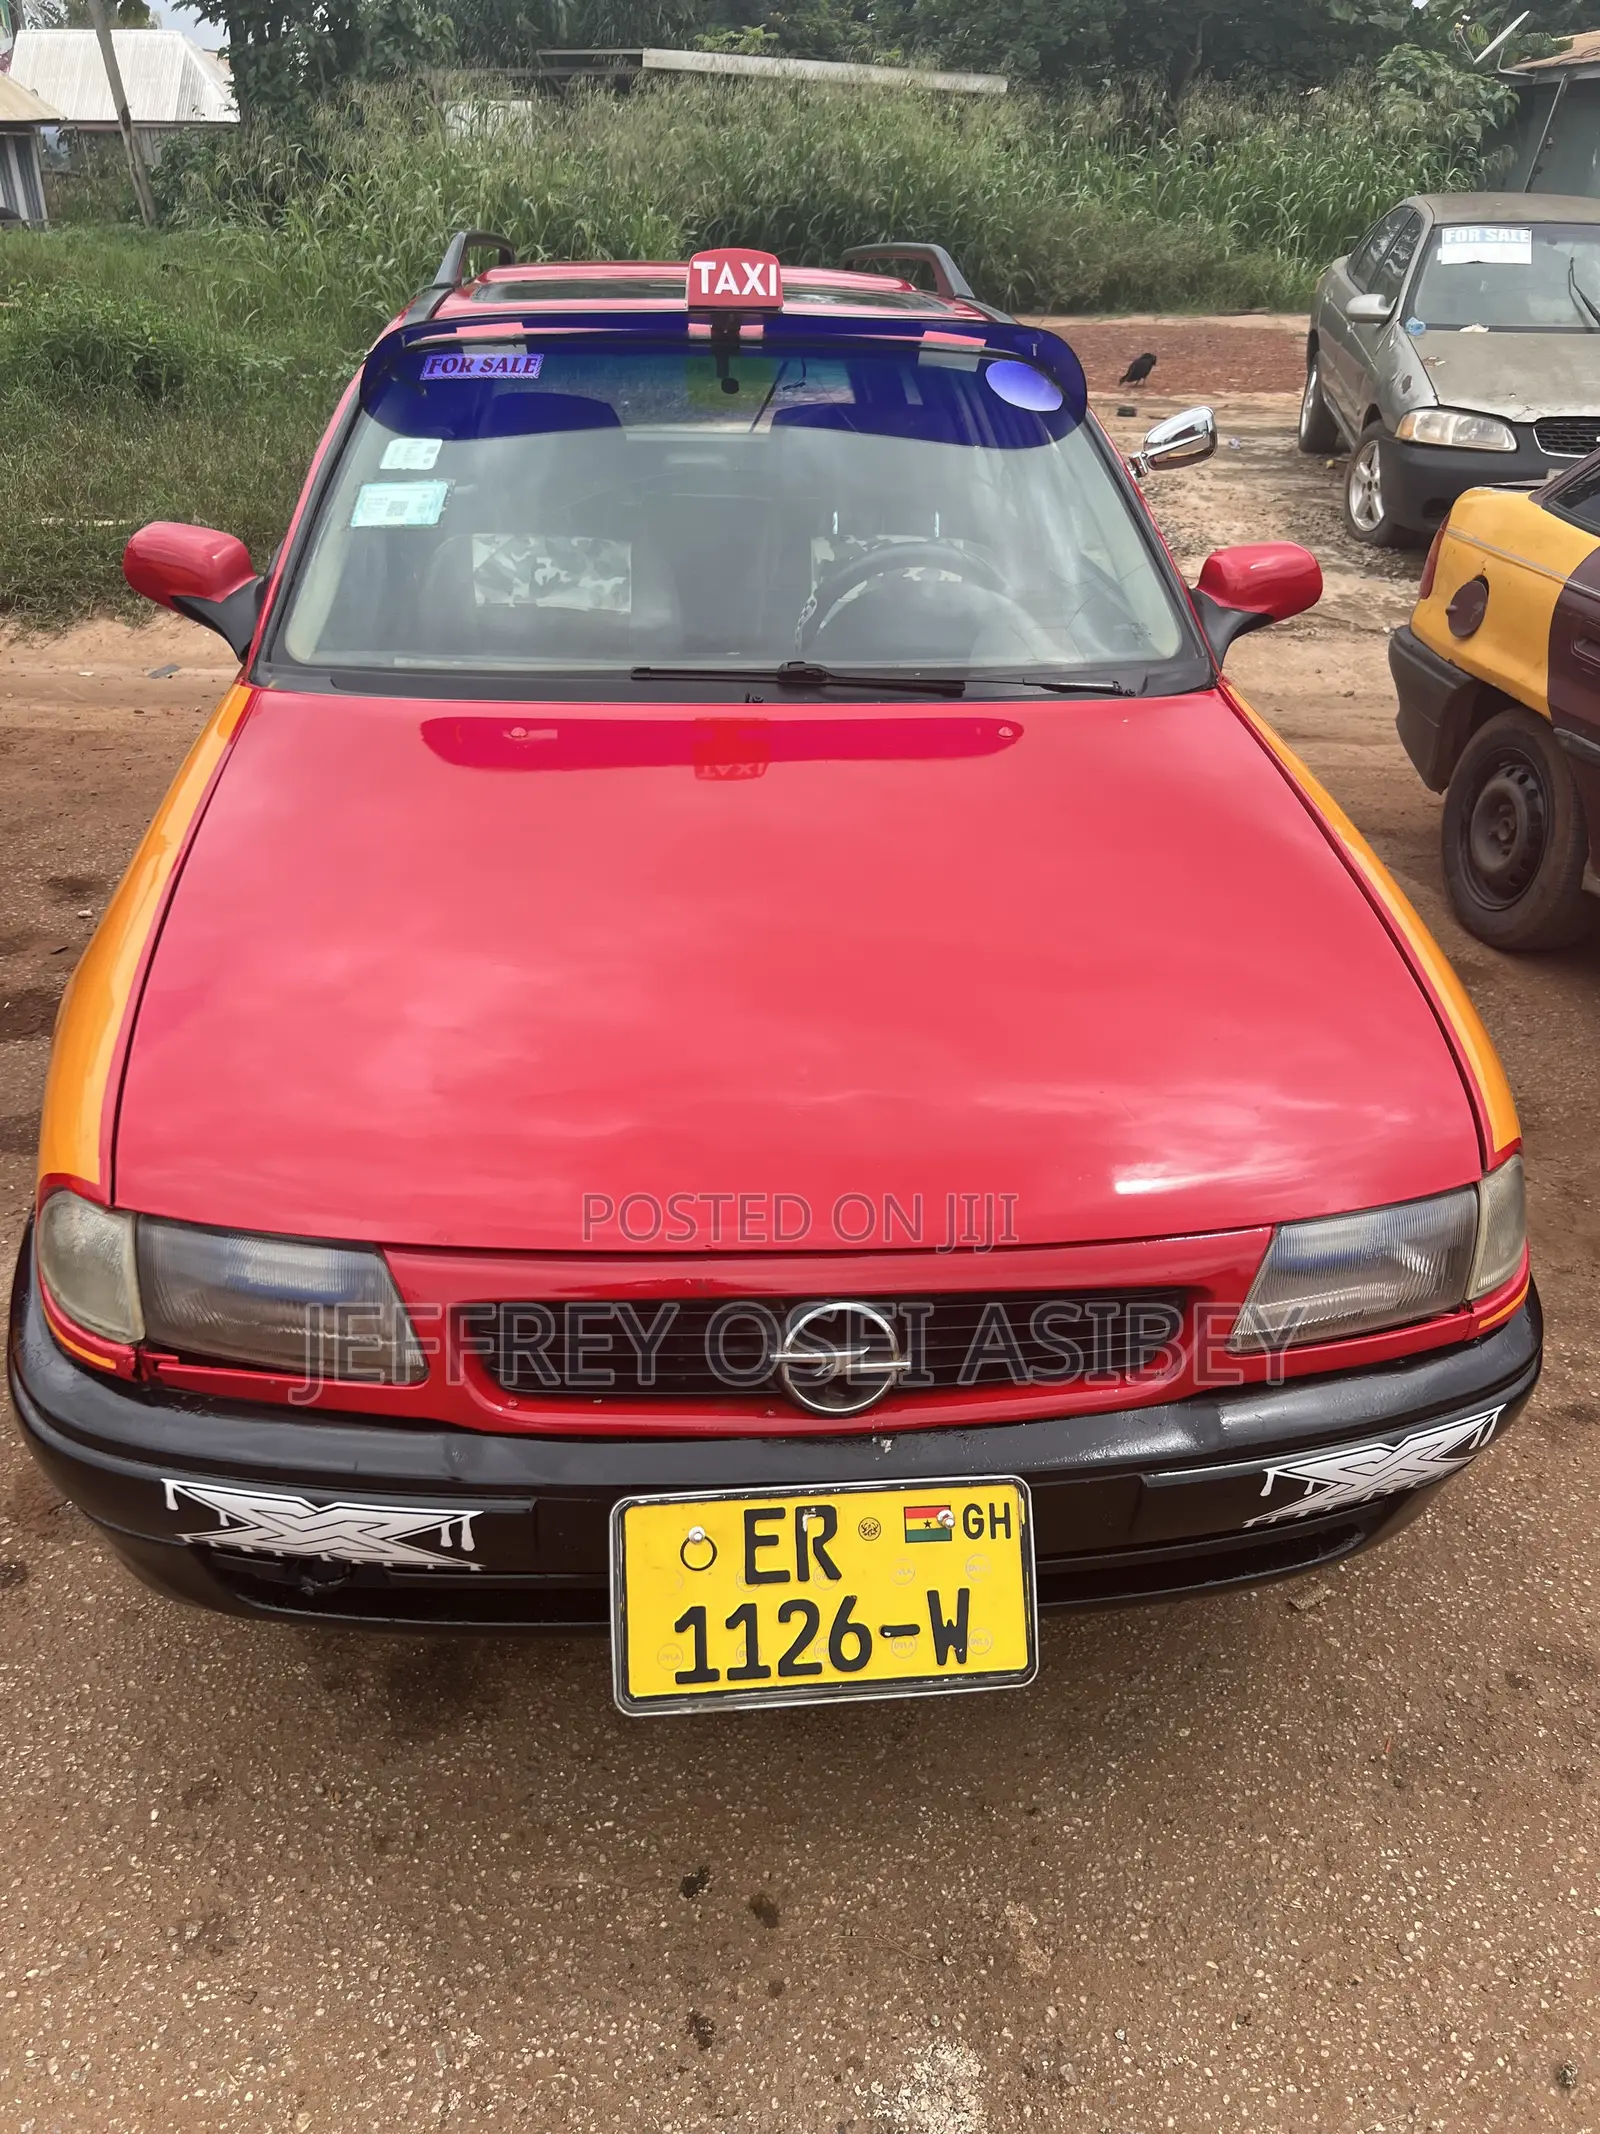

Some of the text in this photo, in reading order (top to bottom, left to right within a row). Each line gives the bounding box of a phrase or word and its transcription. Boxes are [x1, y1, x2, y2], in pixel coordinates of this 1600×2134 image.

[1445, 229, 1529, 243] FOR SALE
[693, 261, 777, 297] TAXI
[427, 357, 538, 375] FOR SALE
[744, 1503, 1011, 1585] ER GH
[674, 1587, 970, 1684] 1126-W
